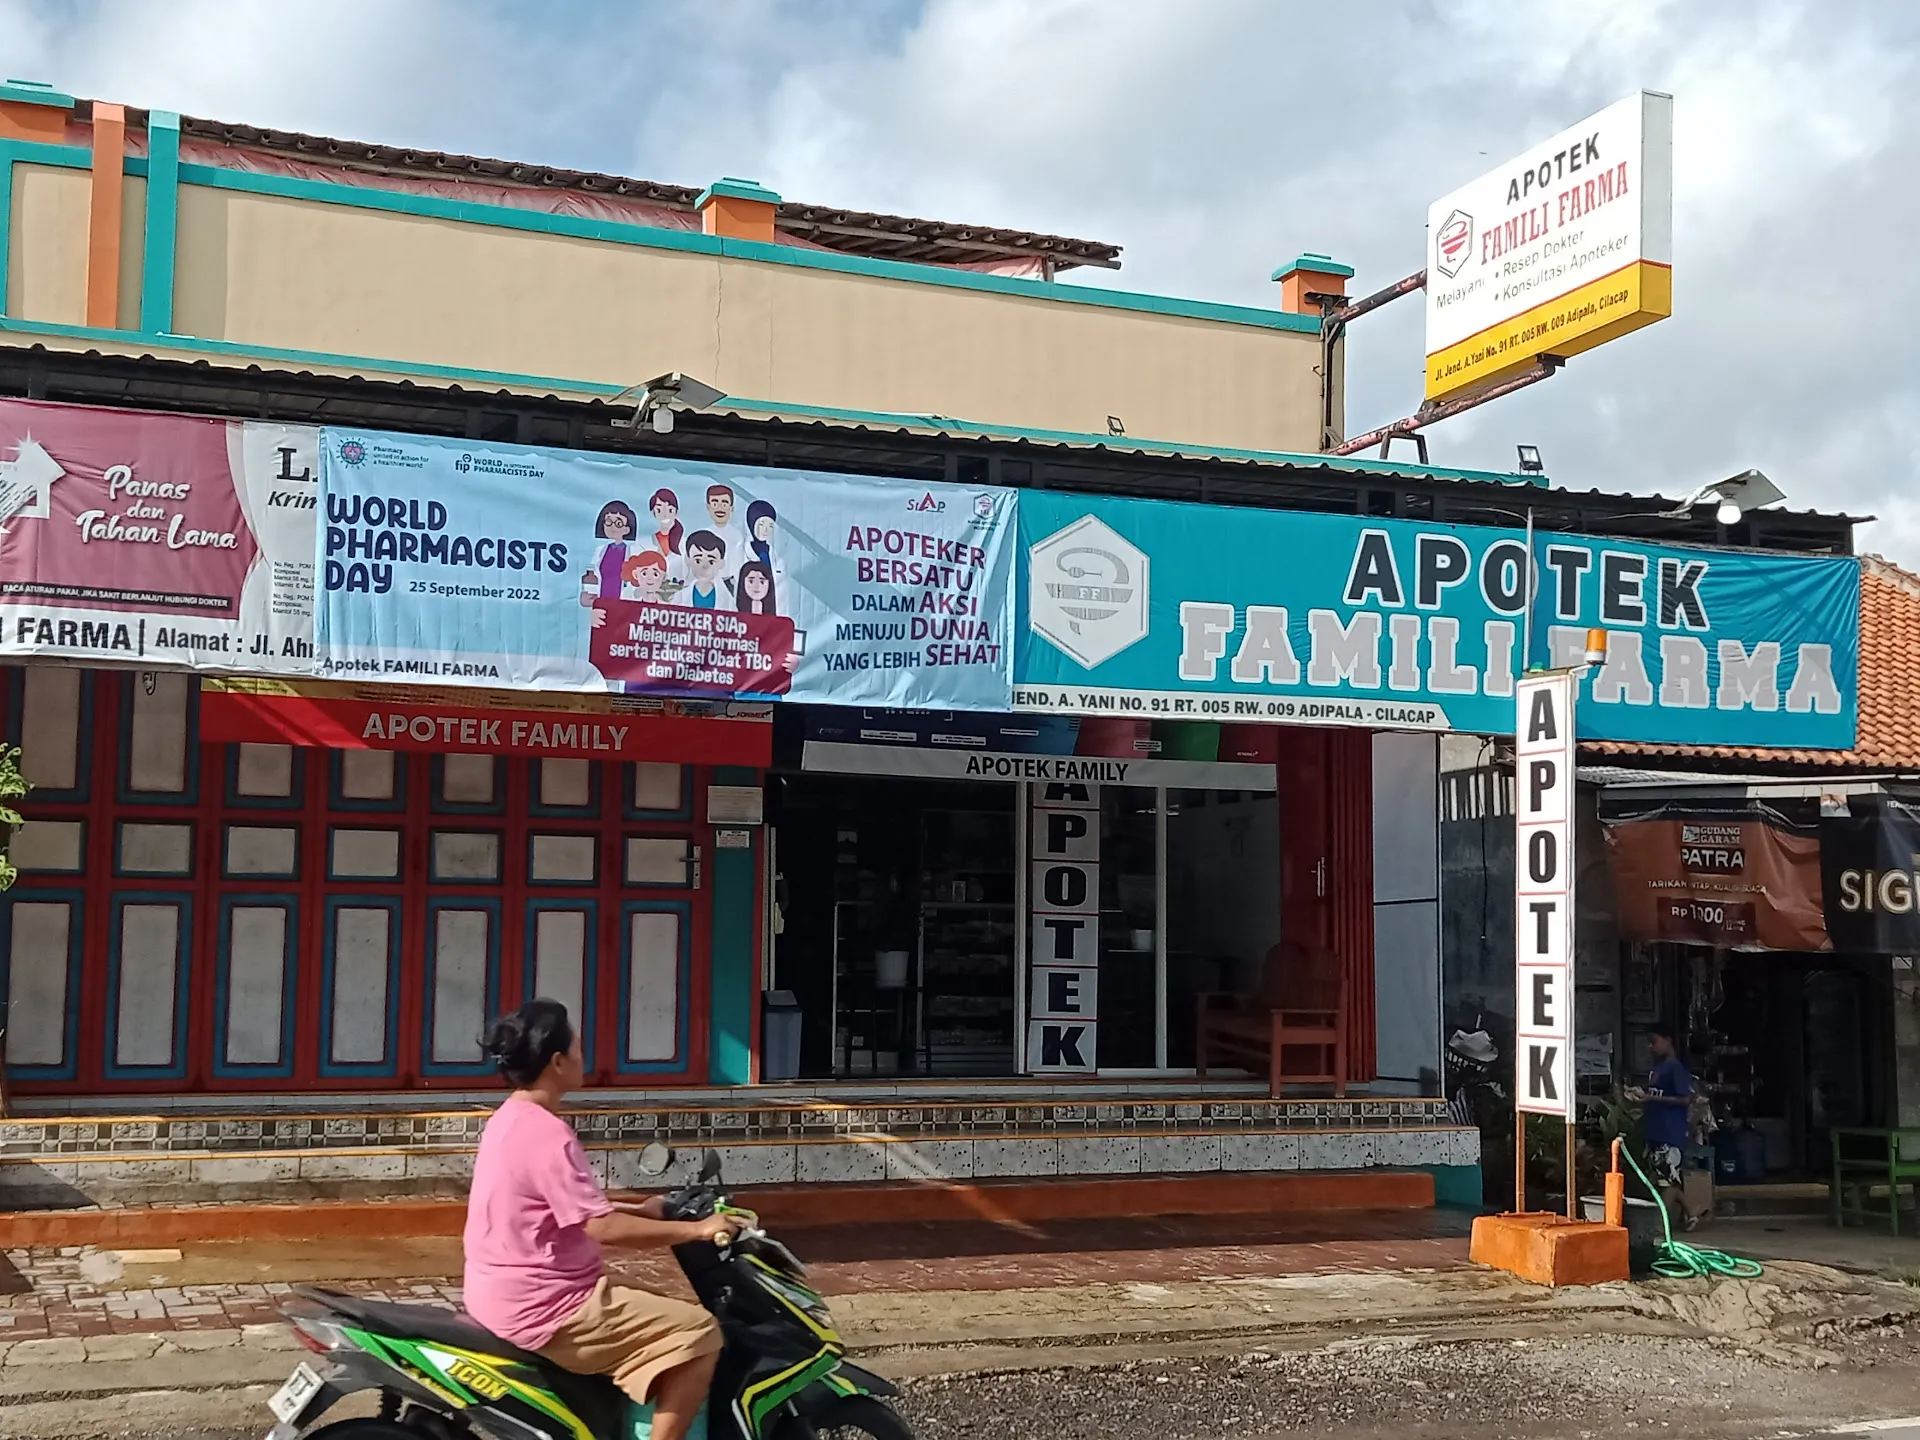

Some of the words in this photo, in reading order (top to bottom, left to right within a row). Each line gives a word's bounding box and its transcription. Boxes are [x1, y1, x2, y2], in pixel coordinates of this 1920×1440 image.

[1507, 132, 1600, 205] APOTEK
[1481, 202, 1548, 265] FAMILI
[1558, 161, 1628, 227] FARMA
[1503, 252, 1539, 277] Resep
[1544, 230, 1584, 259] Dokter
[1437, 277, 1485, 308] Melayani
[1503, 263, 1566, 301] Konsultasi
[1570, 234, 1629, 268] Apoteker
[1436, 369, 1444, 381] Jl.
[1445, 360, 1462, 376] Jend.
[1486, 344, 1498, 356] No.
[1499, 340, 1507, 351] 91
[1509, 334, 1520, 348] RT.
[1522, 329, 1535, 342] 005
[1536, 324, 1550, 338] RW.
[1551, 316, 1565, 330] 009
[1566, 302, 1597, 323] Adipala,
[1599, 289, 1629, 310] Cilacap
[374, 446, 402, 454] Pharmacy
[378, 459, 405, 467] healthier
[456, 460, 470, 473] fip
[474, 458, 502, 466] WORLD
[474, 466, 527, 477] PHARMACISTS
[104, 465, 191, 500] Panas
[126, 499, 166, 520] dan
[327, 493, 447, 531] WORLD
[76, 510, 160, 543] Tahan
[166, 514, 238, 549] Lama
[326, 527, 568, 573] PHARMACISTS
[846, 525, 984, 569] APOTEKER
[325, 562, 393, 594] DAY
[858, 557, 974, 592] BERSATU
[1342, 528, 1710, 632] APOTEK
[3, 584, 24, 593] BACA
[25, 586, 55, 594] ATURAN
[56, 588, 80, 597] PAKAI,
[81, 589, 97, 598] JIKA
[99, 590, 120, 599] SAKIT
[122, 592, 164, 602] BERLANJUT
[164, 594, 197, 604] HUBUNGI
[198, 597, 228, 607] DOKTER
[410, 581, 426, 594] 25
[429, 581, 505, 598] September
[507, 587, 540, 601] 2022
[852, 594, 915, 612] DALAM
[919, 591, 977, 616] AKSI
[639, 607, 712, 630] APOTEKER
[836, 623, 905, 641] MENUJU
[911, 618, 990, 641] DUNIA
[16, 617, 131, 650] FARMA
[155, 627, 229, 652] Alamat
[250, 634, 274, 656] Jl.
[629, 624, 692, 650] Melayani
[694, 631, 760, 653] Informasi
[1178, 601, 1515, 698] FAMILI
[323, 656, 380, 673] Apotek
[384, 660, 438, 675] FAMILI
[442, 663, 499, 678] FARMA
[610, 643, 648, 660] serta
[652, 644, 705, 665] Edukasi
[708, 650, 741, 668] Obat
[744, 654, 772, 671] TBC
[824, 652, 869, 671] YANG
[873, 652, 920, 668] LEBIH
[926, 644, 1001, 666] SEHAT
[647, 662, 672, 678] dan
[676, 662, 734, 684] Diabetes
[1057, 692, 1075, 706] A.
[1078, 693, 1116, 710] YANI
[1120, 695, 1147, 711] NO.
[1151, 697, 1170, 712] 91
[1174, 699, 1197, 713] RT.
[1201, 699, 1230, 714] 005
[1234, 701, 1263, 716] RW.
[1267, 702, 1295, 717] 009
[1299, 703, 1362, 720] ADIPALA
[1375, 707, 1436, 724] CILACAP
[362, 713, 502, 746] APOTEK
[511, 720, 629, 750] FAMILY
[966, 755, 1050, 778] APOTEK
[1055, 760, 1128, 782] FAMILY
[1700, 827, 1740, 835] GUDANG
[1701, 836, 1740, 844] GARAM
[1682, 848, 1744, 868] PATRA
[1527, 688, 1558, 1100] APOTEK
[1648, 880, 1687, 888] TARIKAN
[1672, 907, 1687, 917] Rp
[446, 1359, 508, 1398] ICON
